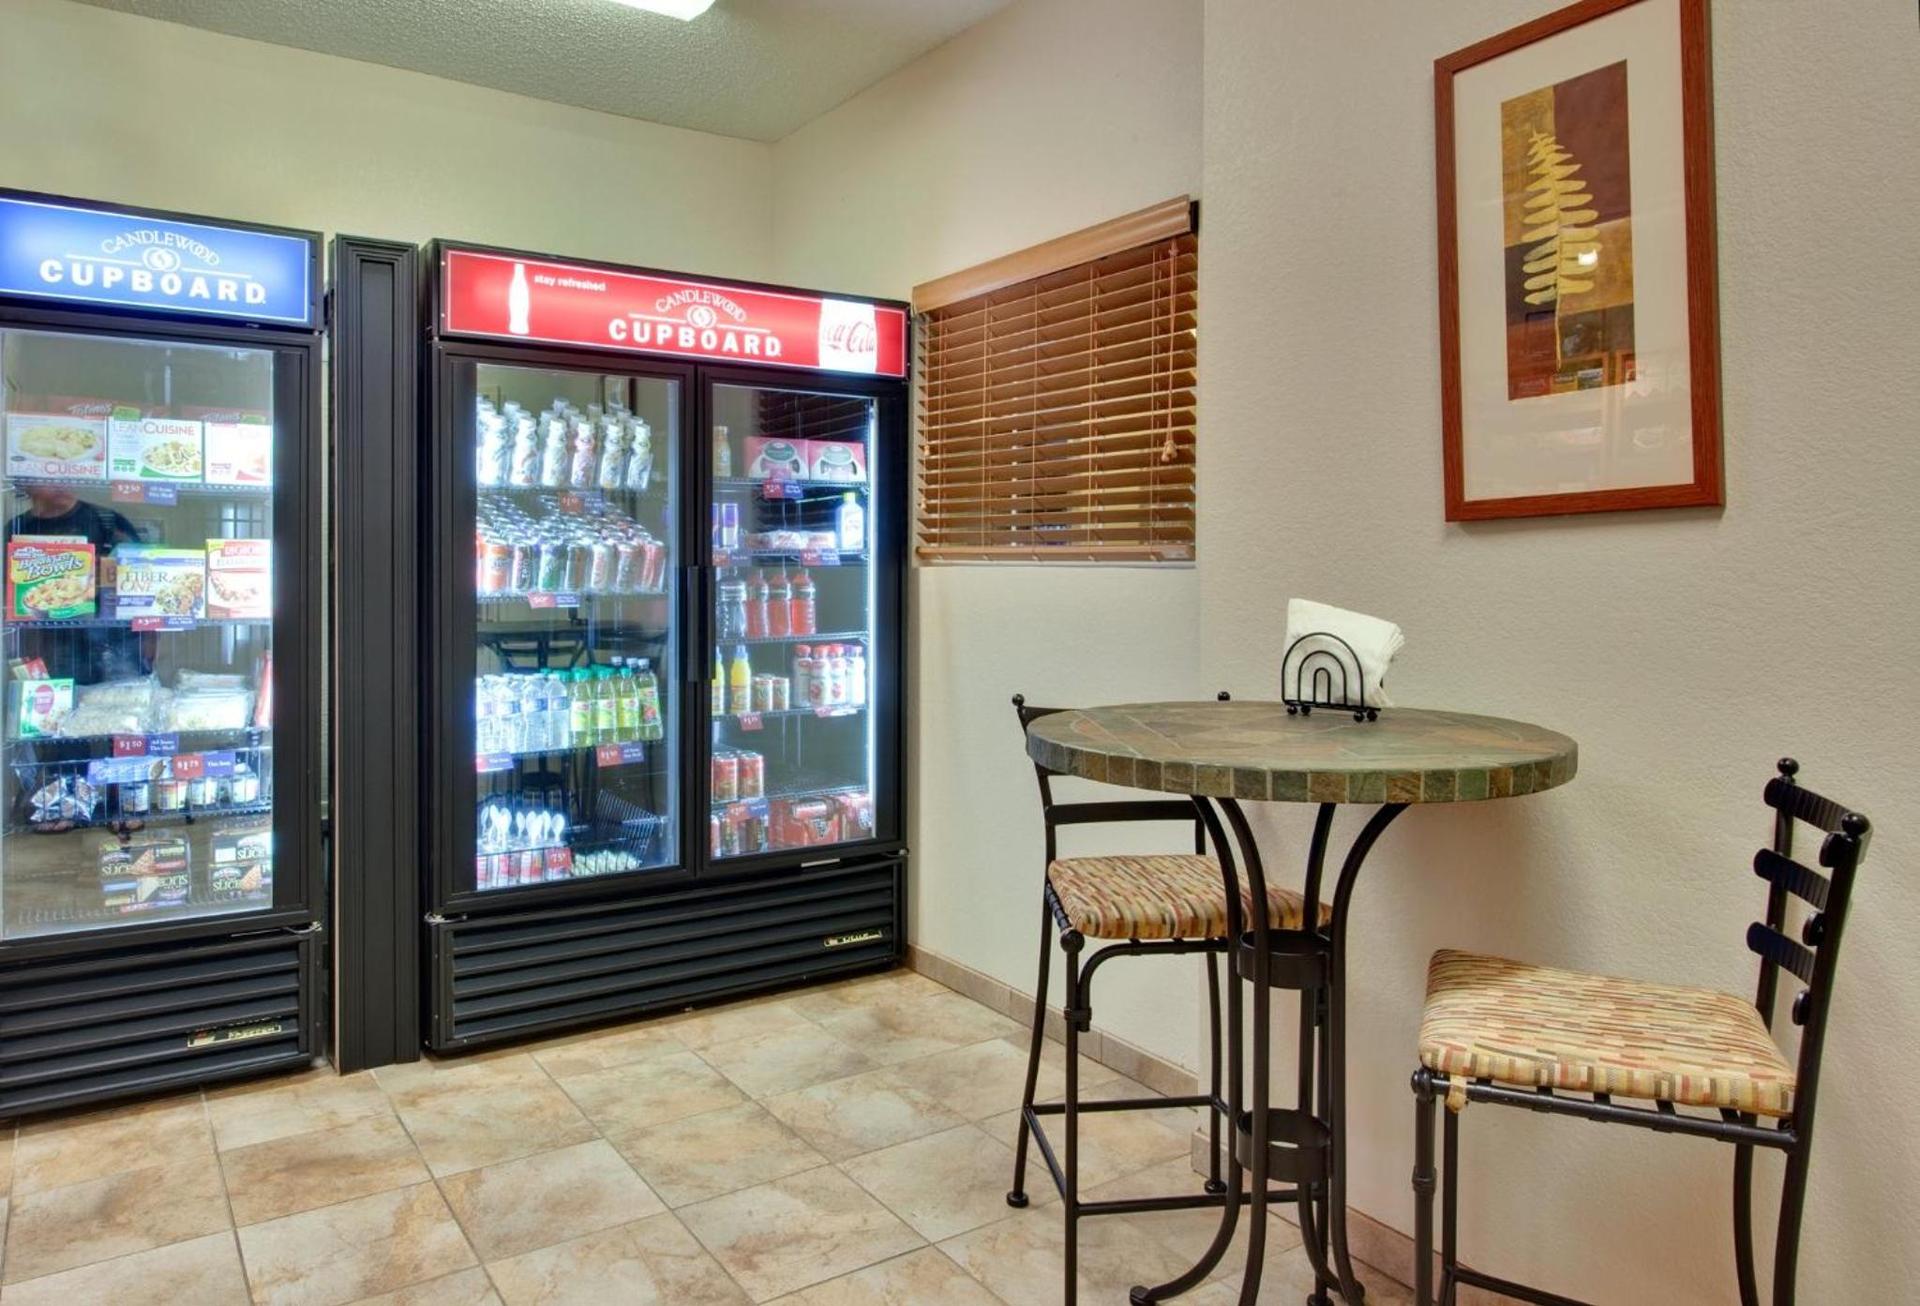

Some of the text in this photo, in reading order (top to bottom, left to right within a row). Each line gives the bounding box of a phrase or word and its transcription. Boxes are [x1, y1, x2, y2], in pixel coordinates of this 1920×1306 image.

[101, 230, 220, 266] CANDLEWOOD
[39, 259, 267, 305] CUPBOARD
[534, 274, 555, 288] stay
[655, 289, 747, 323] CANDLEWOOD
[608, 319, 782, 358] CUPBOARD
